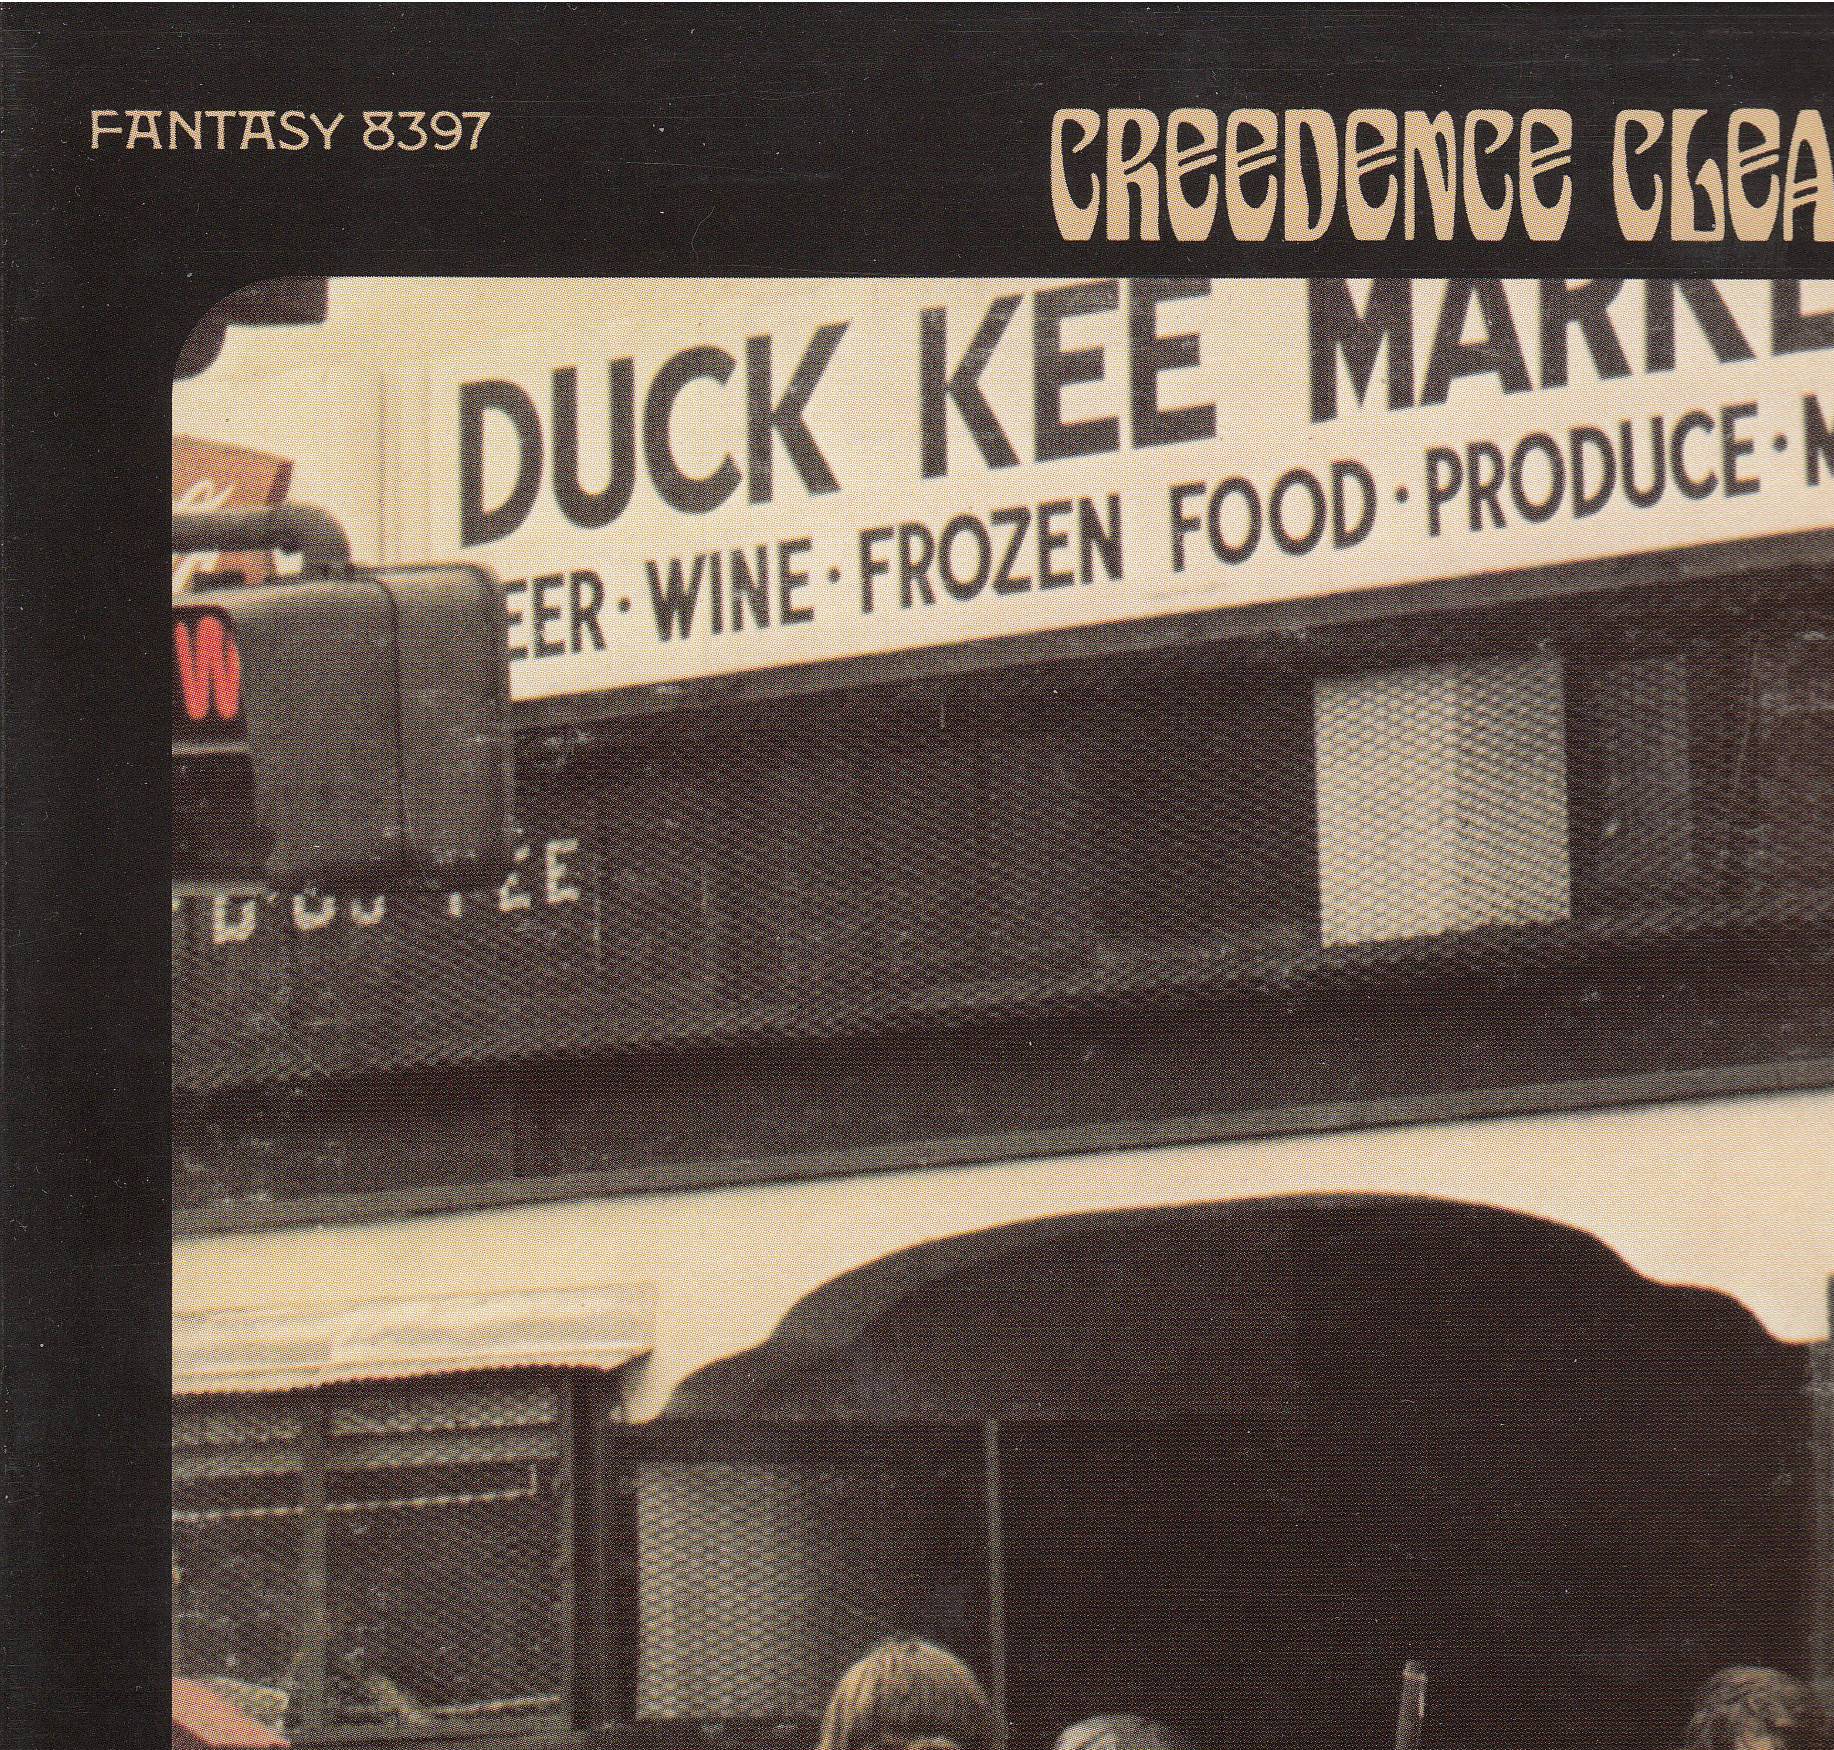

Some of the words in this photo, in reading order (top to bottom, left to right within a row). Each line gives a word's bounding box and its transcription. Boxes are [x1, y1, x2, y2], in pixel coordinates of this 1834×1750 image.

[90, 109, 345, 151] FANTASY
[362, 110, 491, 151] 8397
[1050, 107, 1573, 242] CREEDENCE
[458, 321, 850, 548] DUCK
[919, 278, 1218, 480] KEE
[501, 568, 606, 662] EER
[644, 535, 815, 643] WINE
[858, 492, 1124, 615] FROZEN
[1169, 459, 1379, 573] FOOD
[1425, 402, 1761, 538] PRODUCE
